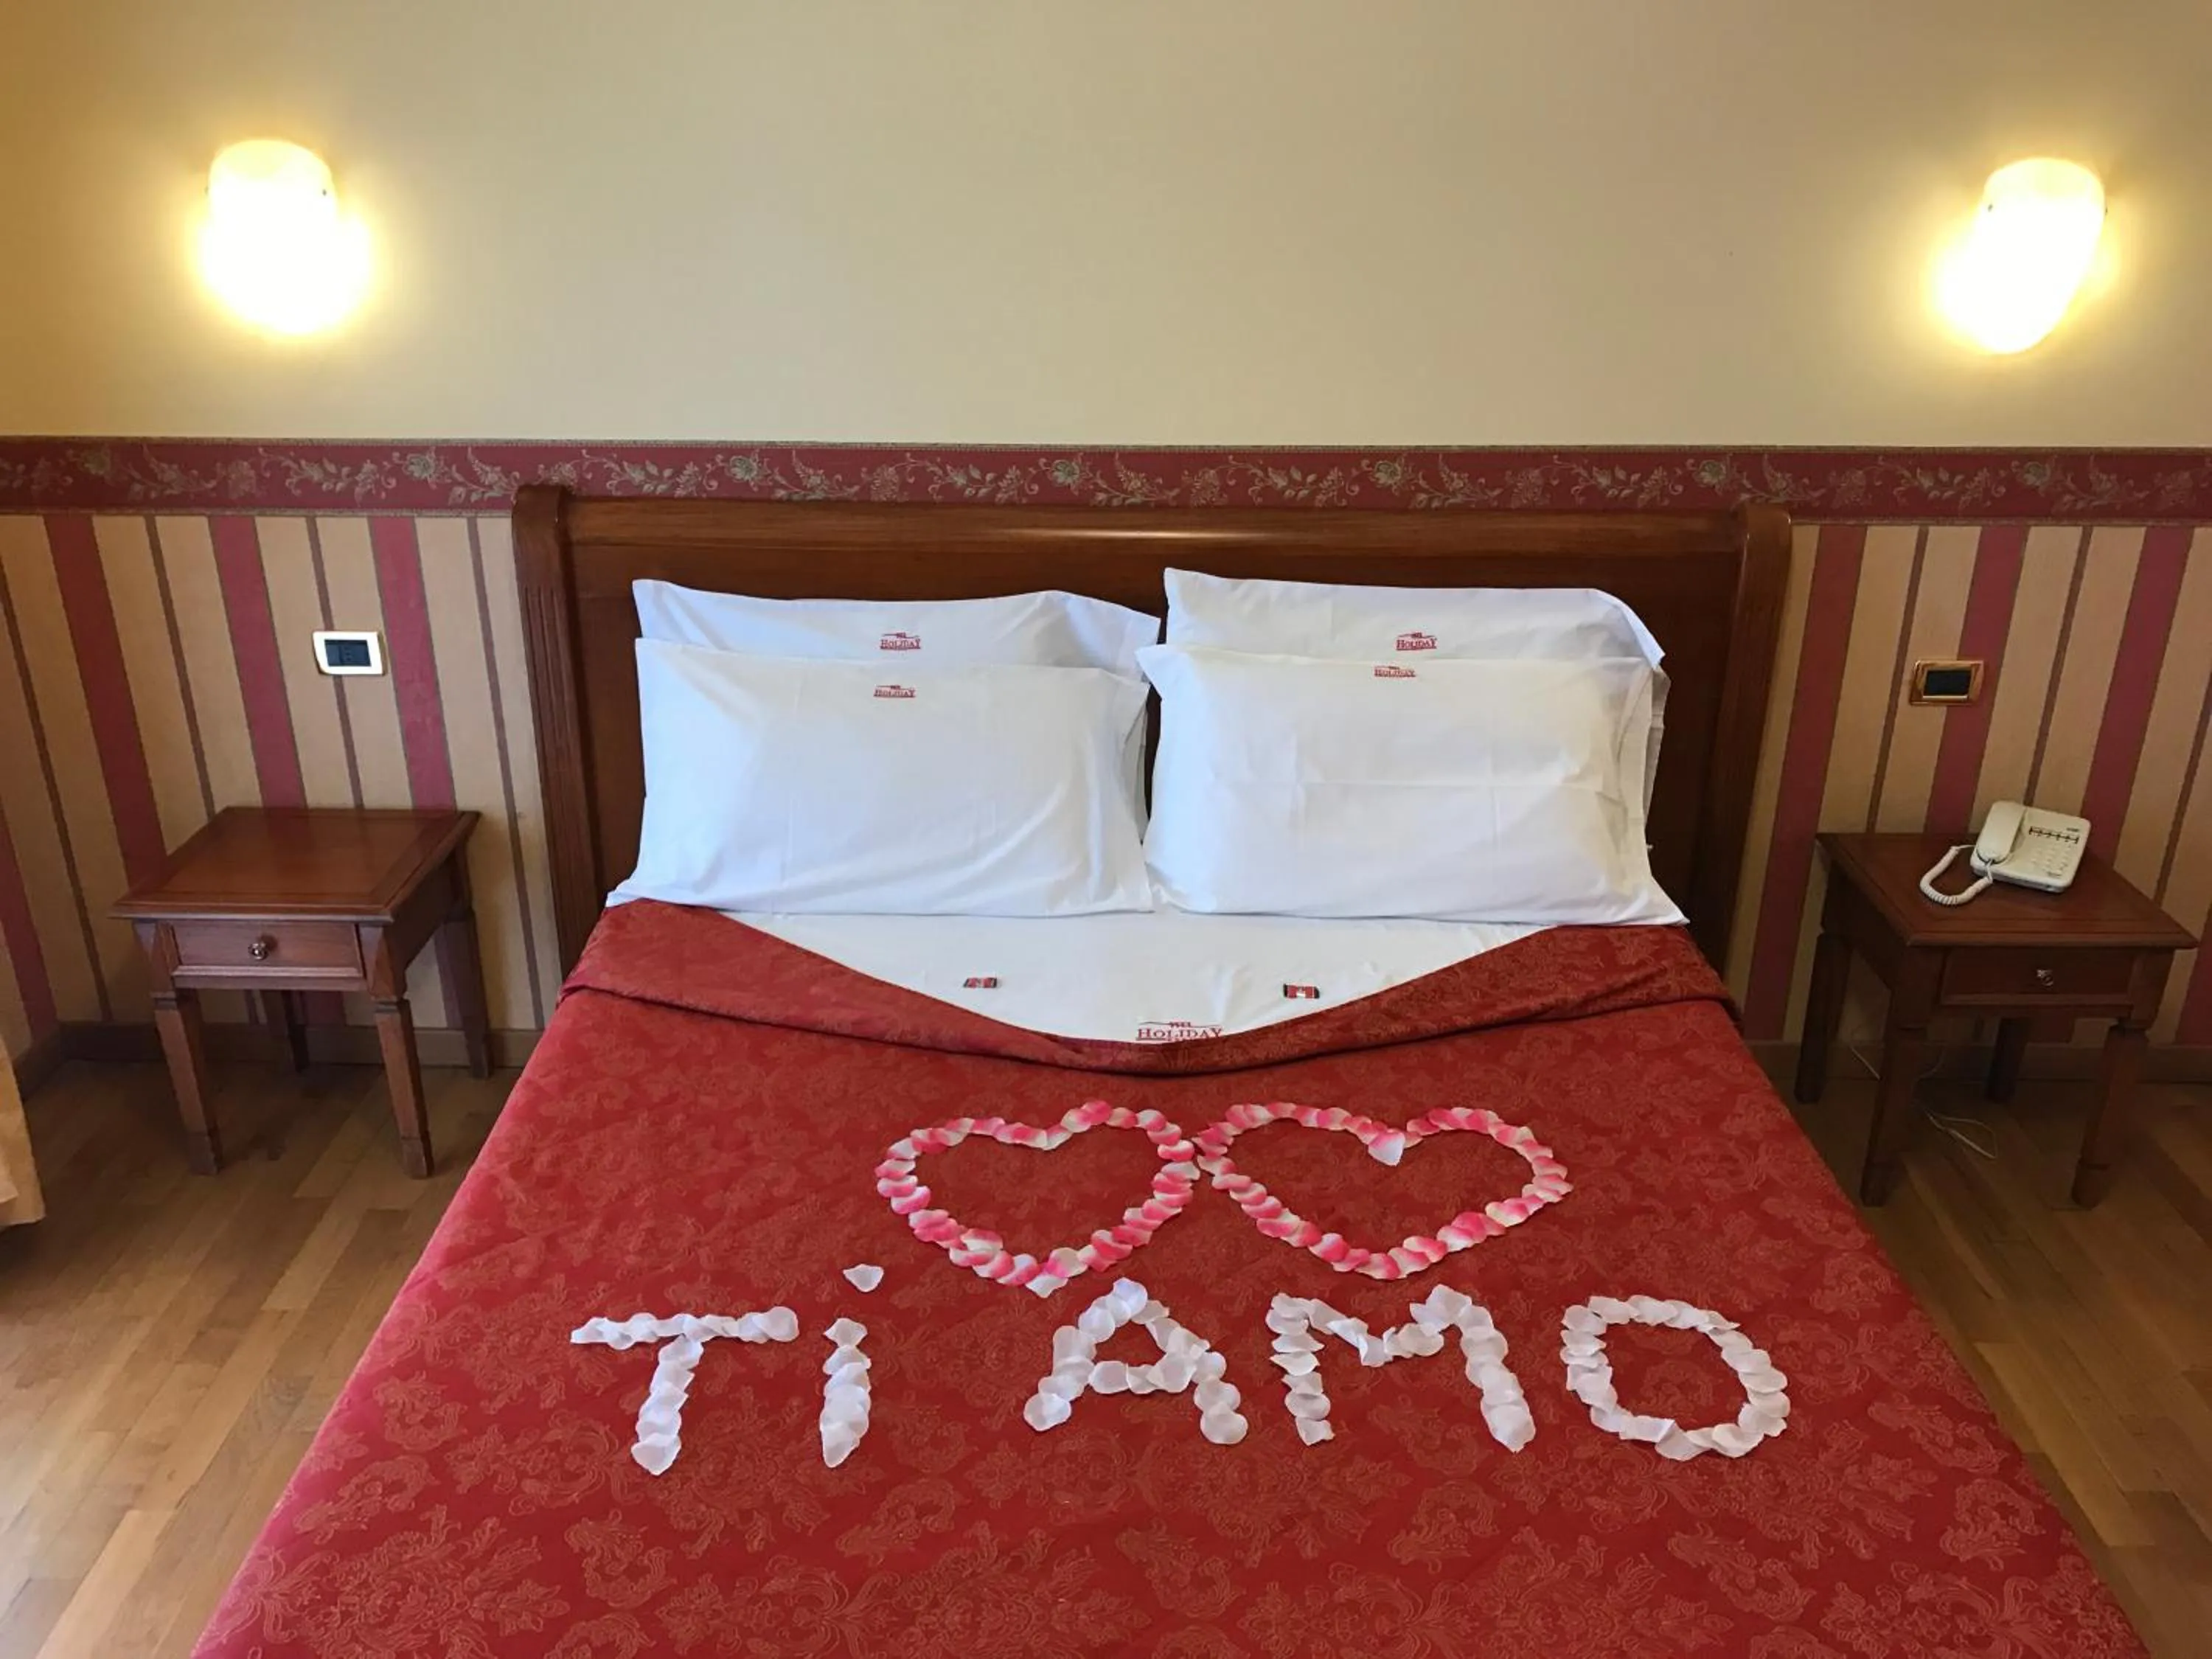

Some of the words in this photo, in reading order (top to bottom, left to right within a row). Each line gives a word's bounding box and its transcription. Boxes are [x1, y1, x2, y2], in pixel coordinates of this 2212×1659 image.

[1397, 638, 1437, 648] HOLIDAY
[1138, 1028, 1222, 1040] HOLIDAY
[1023, 1276, 1790, 1461] AMO
